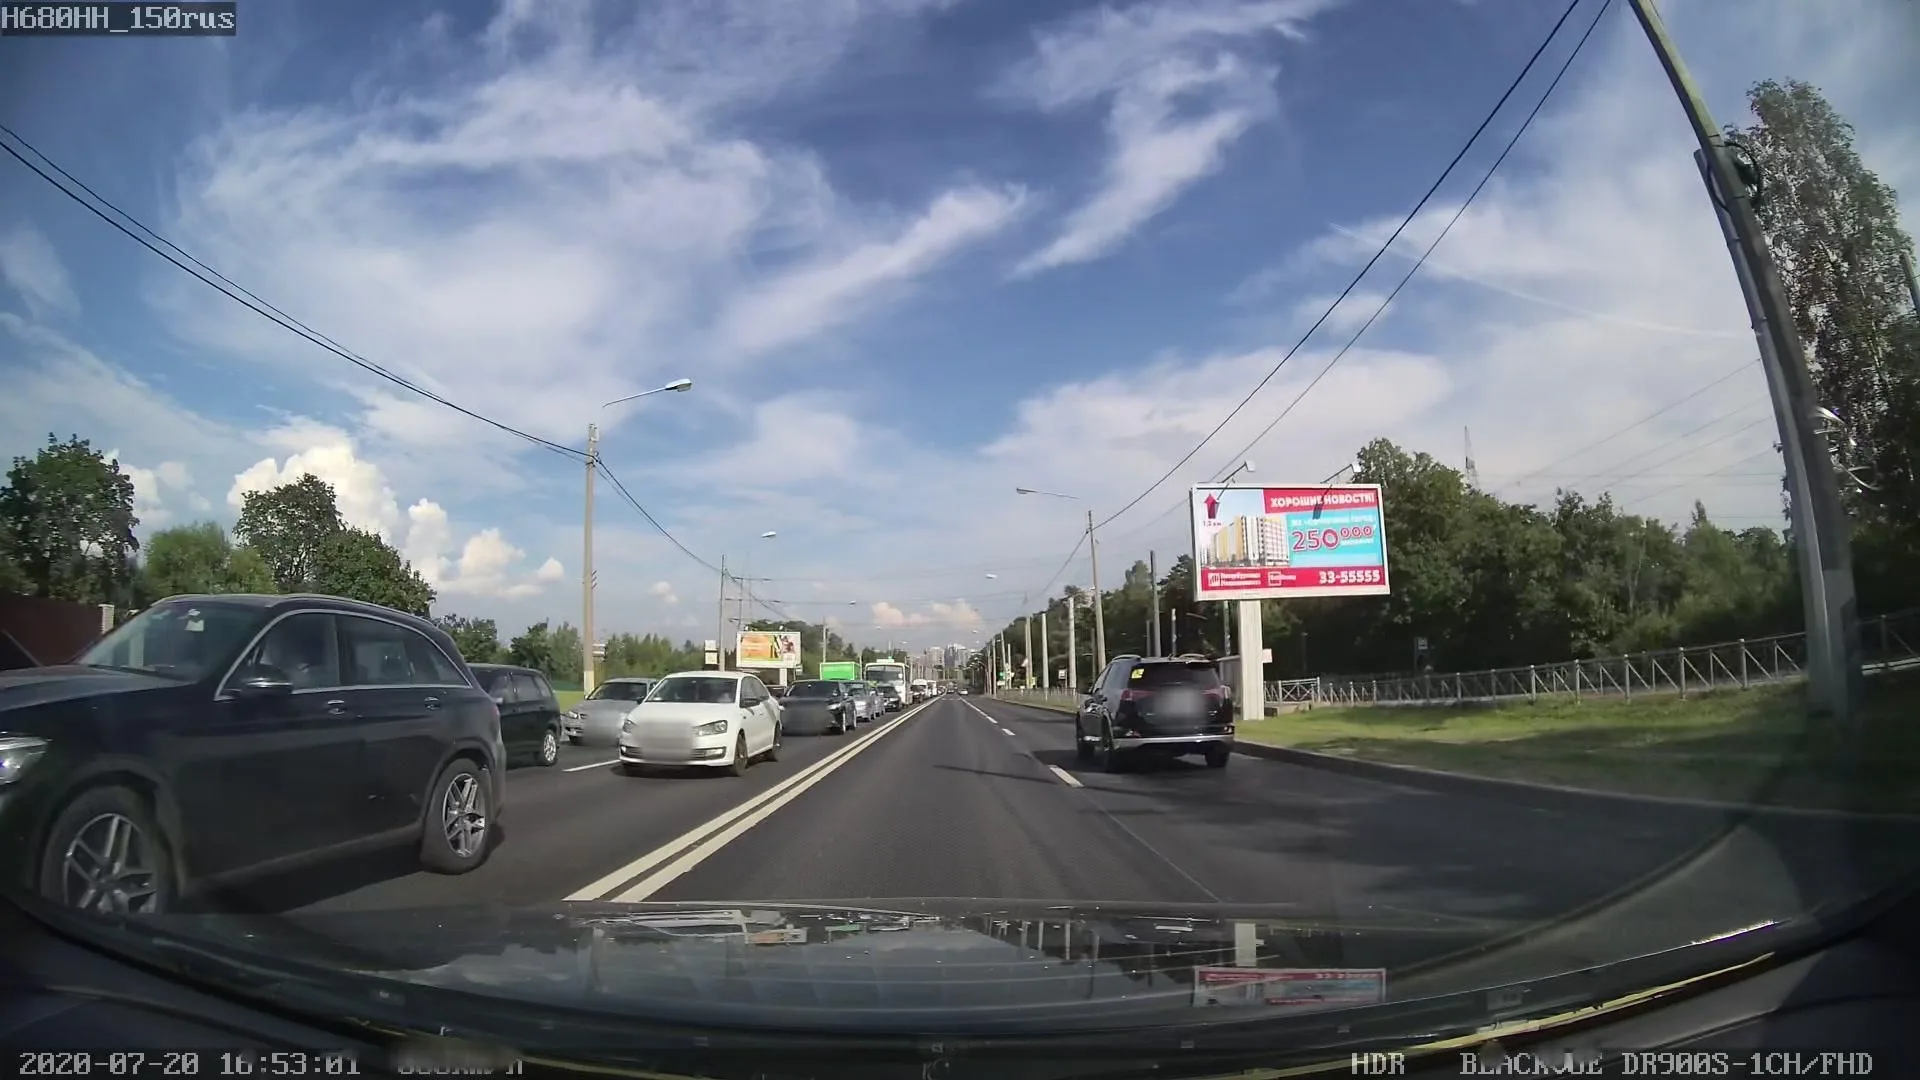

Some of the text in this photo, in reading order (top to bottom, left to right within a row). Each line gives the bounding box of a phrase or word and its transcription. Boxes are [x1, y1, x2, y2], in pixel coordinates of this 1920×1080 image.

[1270, 492, 1375, 508] ХОРОШИЕ НОВОСТИ!
[1318, 569, 1381, 585] 33-55555
